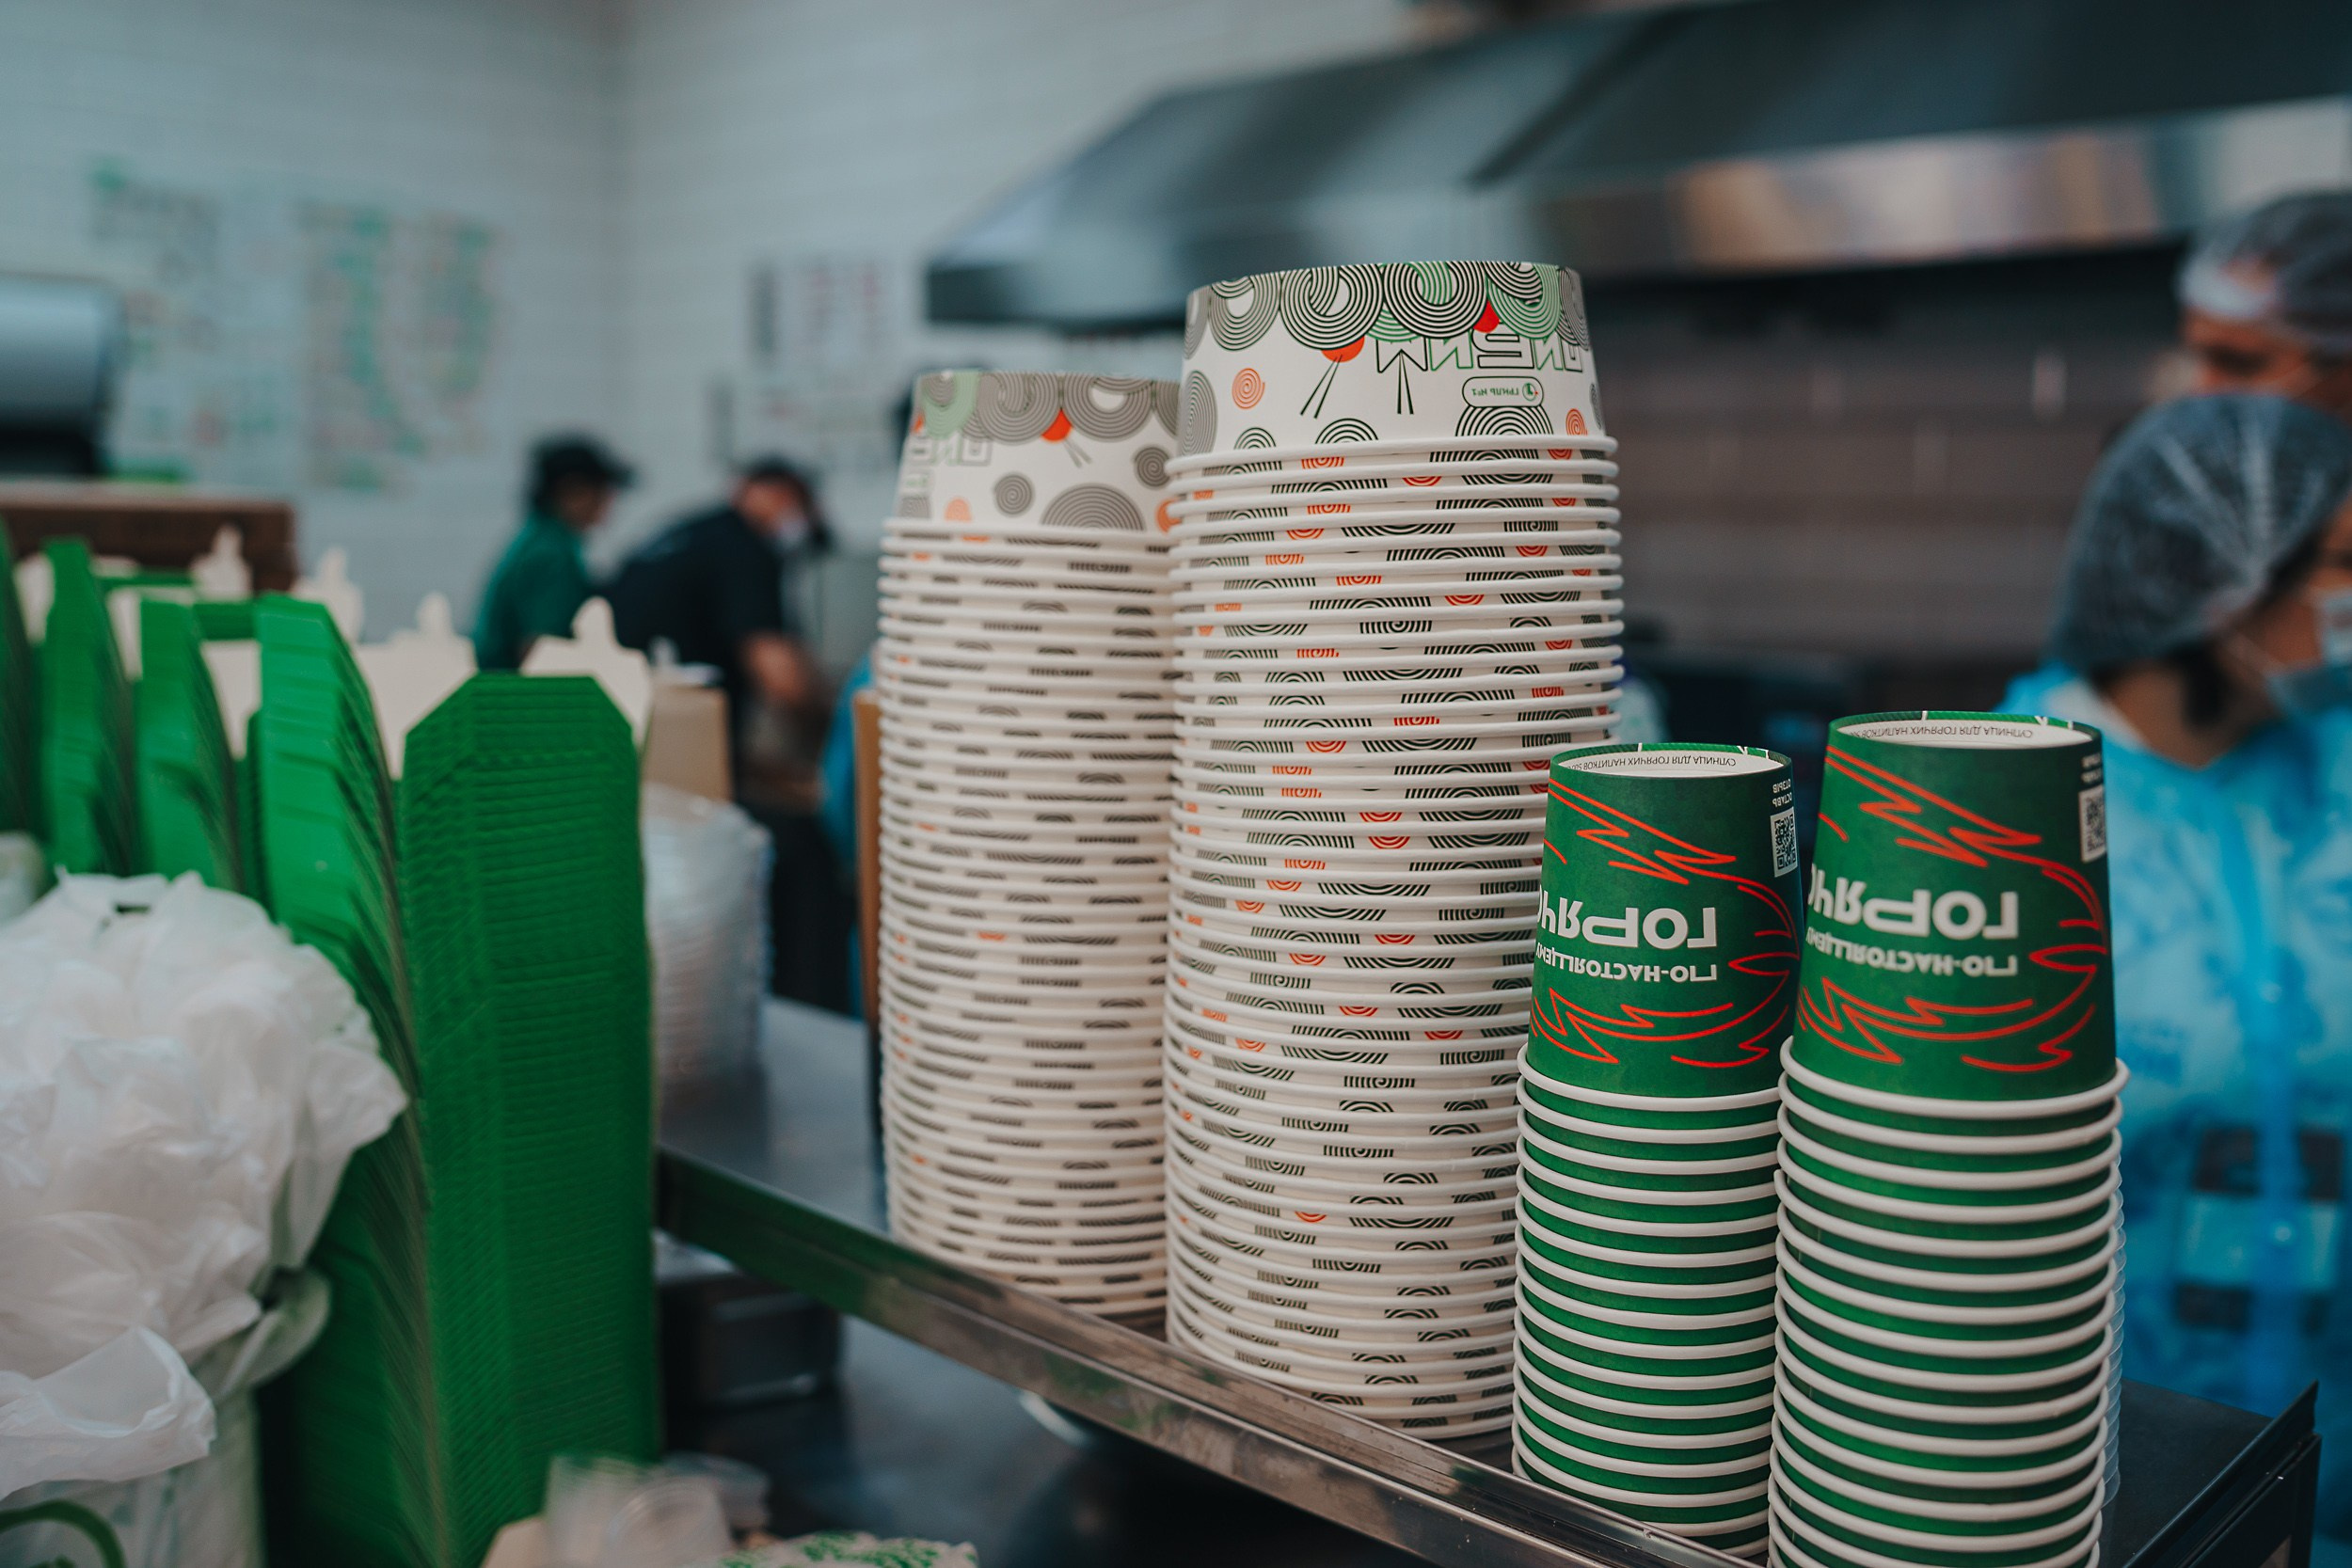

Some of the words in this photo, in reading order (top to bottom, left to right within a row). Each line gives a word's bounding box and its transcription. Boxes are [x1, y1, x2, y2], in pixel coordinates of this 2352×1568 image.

[1470, 388, 1488, 398] №1
[1489, 387, 1520, 397] ГРИЛЬ
[1910, 725, 1958, 738] ГОРЯЧИХ
[1959, 725, 1981, 738] ДЛЯ
[1983, 726, 2034, 739] СУПНИЦА
[1582, 757, 1627, 771] НАПИТКОВ
[1628, 755, 1670, 768] ГОРЯЧИХ
[1671, 754, 1692, 767] ДЛЯ
[1692, 755, 1737, 768] СУПНИЦА
[1772, 778, 1792, 794] ОТЗЫВ
[1771, 791, 1793, 808] ОСТАВЬ
[1804, 926, 2020, 977] ПО-НАСТОЯЩЕМУ
[1534, 941, 1719, 984] ПО-НАСТОЯЩЕМУ
